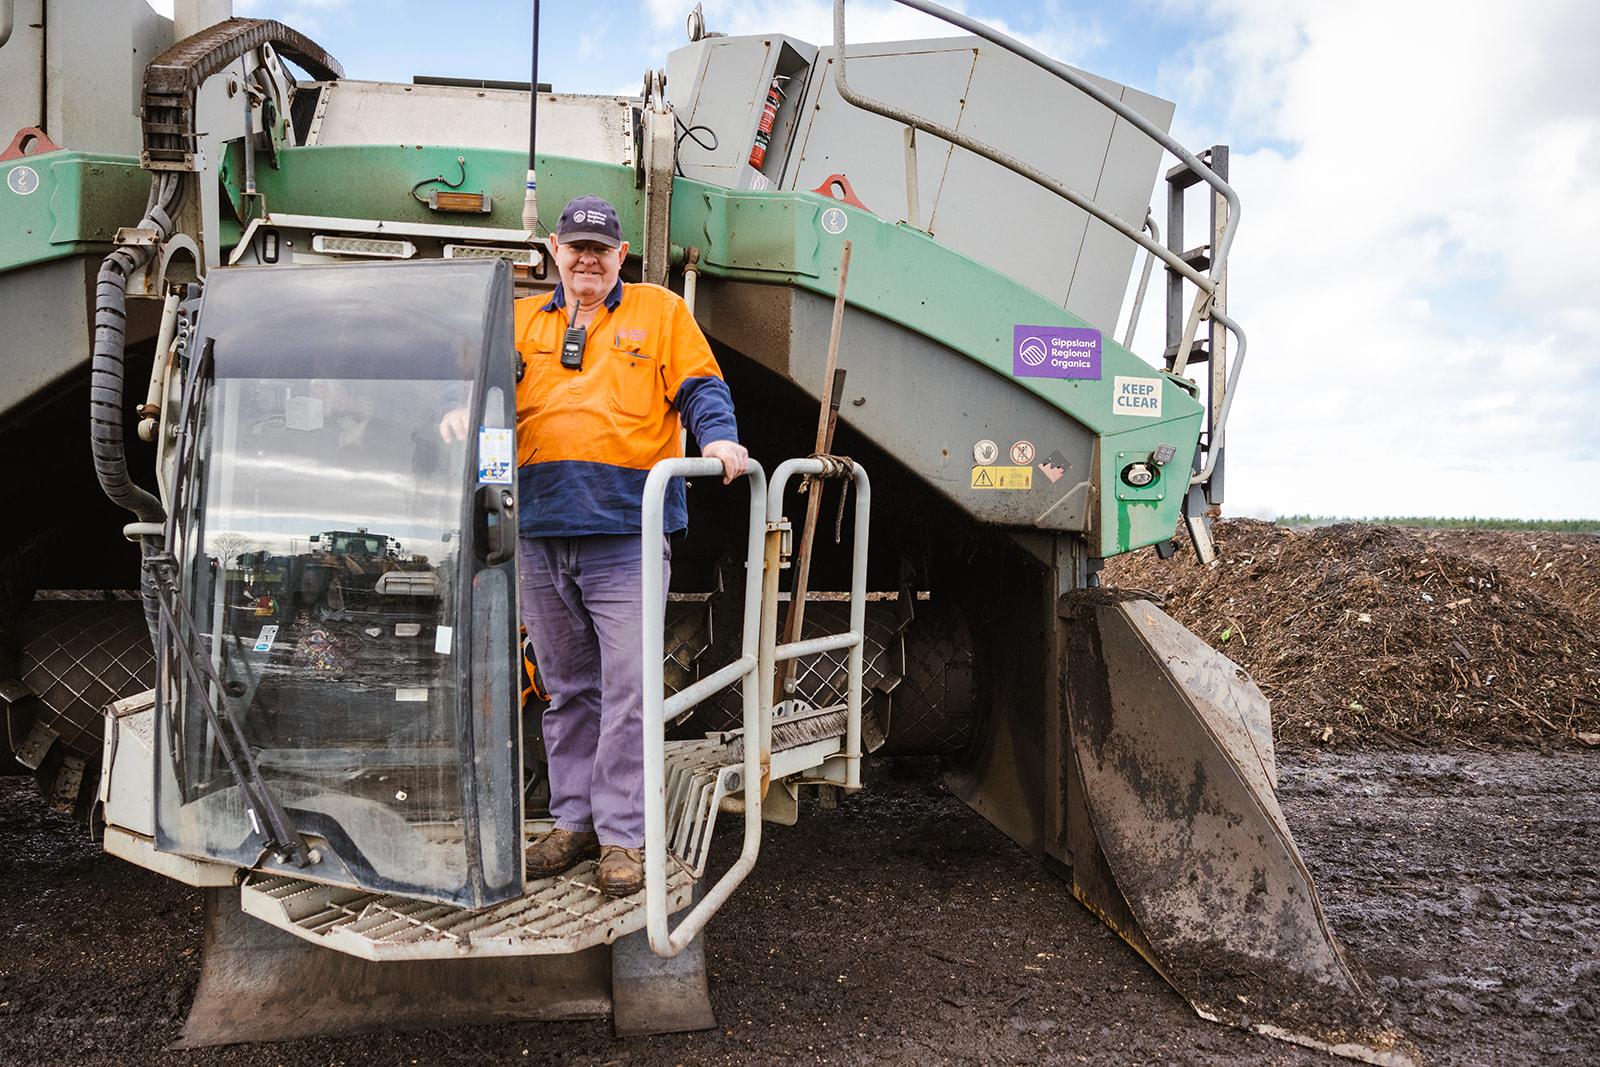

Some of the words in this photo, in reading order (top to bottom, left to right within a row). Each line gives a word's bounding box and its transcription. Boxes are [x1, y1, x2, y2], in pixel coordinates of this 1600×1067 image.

[1051, 338, 1096, 349] Gippsland
[1051, 348, 1091, 359] Regional
[1051, 358, 1091, 369] Organics
[1122, 383, 1154, 396] KEEP
[1117, 396, 1158, 409] CLEAR
